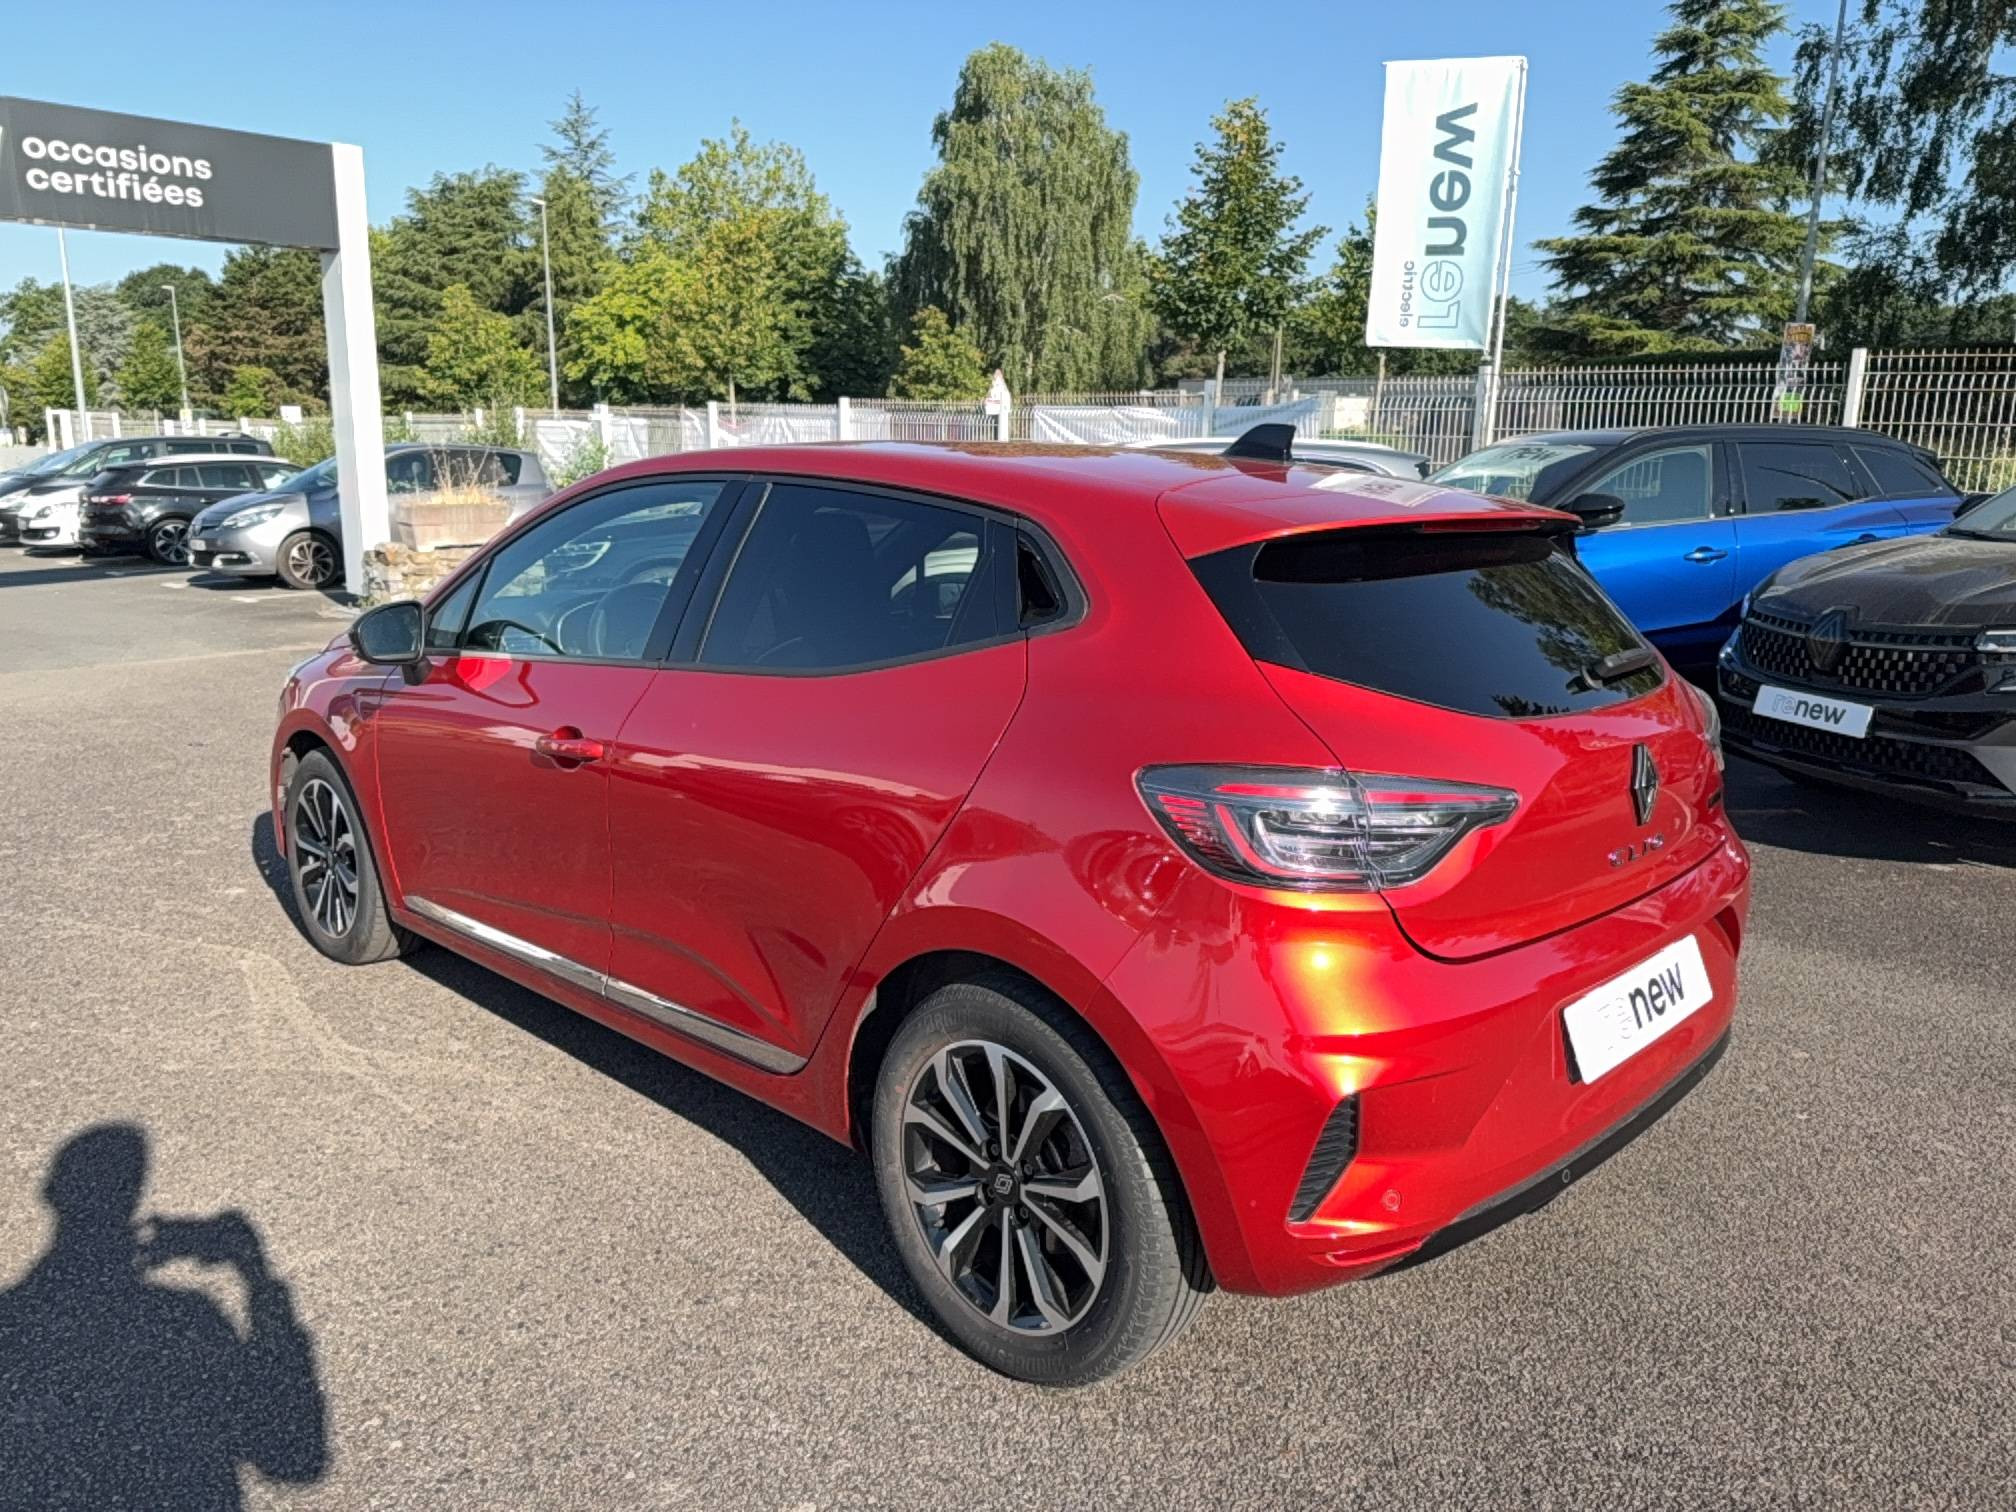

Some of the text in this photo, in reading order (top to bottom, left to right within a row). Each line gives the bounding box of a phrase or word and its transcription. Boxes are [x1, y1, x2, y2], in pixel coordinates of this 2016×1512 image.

[22, 136, 213, 180] occasions
[26, 167, 204, 207] certifiées
[1772, 693, 1847, 725] renew
[1607, 832, 1664, 867] CLIO
